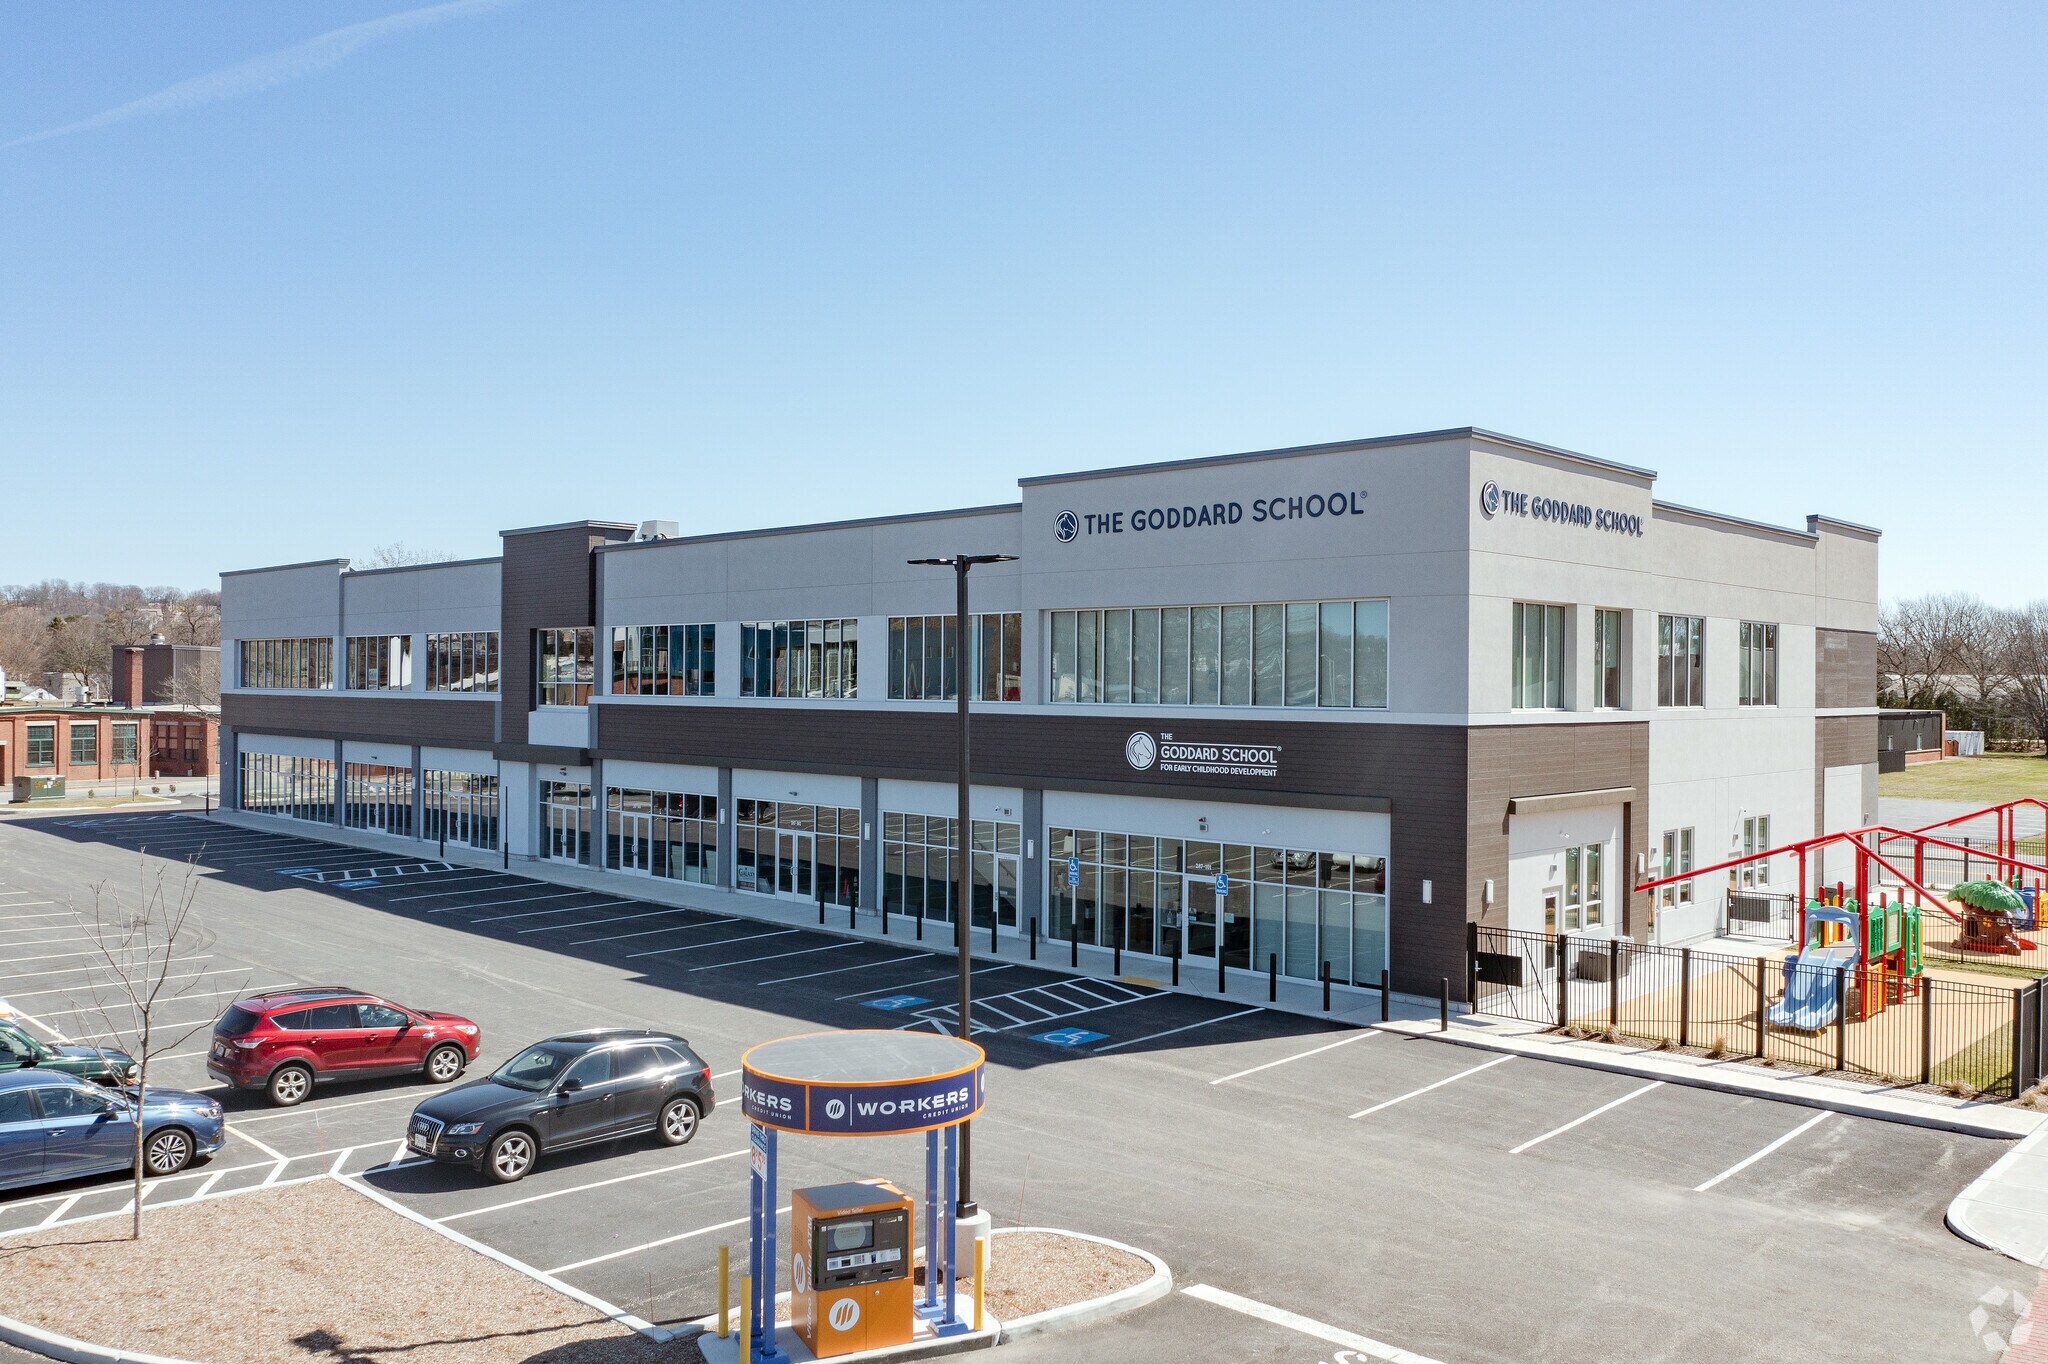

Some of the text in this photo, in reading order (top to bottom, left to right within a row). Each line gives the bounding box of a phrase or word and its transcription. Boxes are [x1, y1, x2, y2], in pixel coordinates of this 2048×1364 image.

[1501, 490, 1528, 515] THE
[1531, 496, 1592, 527] GODDARD
[1084, 512, 1124, 535] THE
[1131, 502, 1243, 531] GODDARD
[1160, 746, 1219, 761] GODDARD
[1160, 763, 1278, 777] FOR EARLY CHILDHOOD DEVELOPMENT
[857, 1087, 969, 1116] WORKERS
[751, 1105, 792, 1120] CREDIT UNION
[922, 1103, 969, 1119] CREDIT UNION
